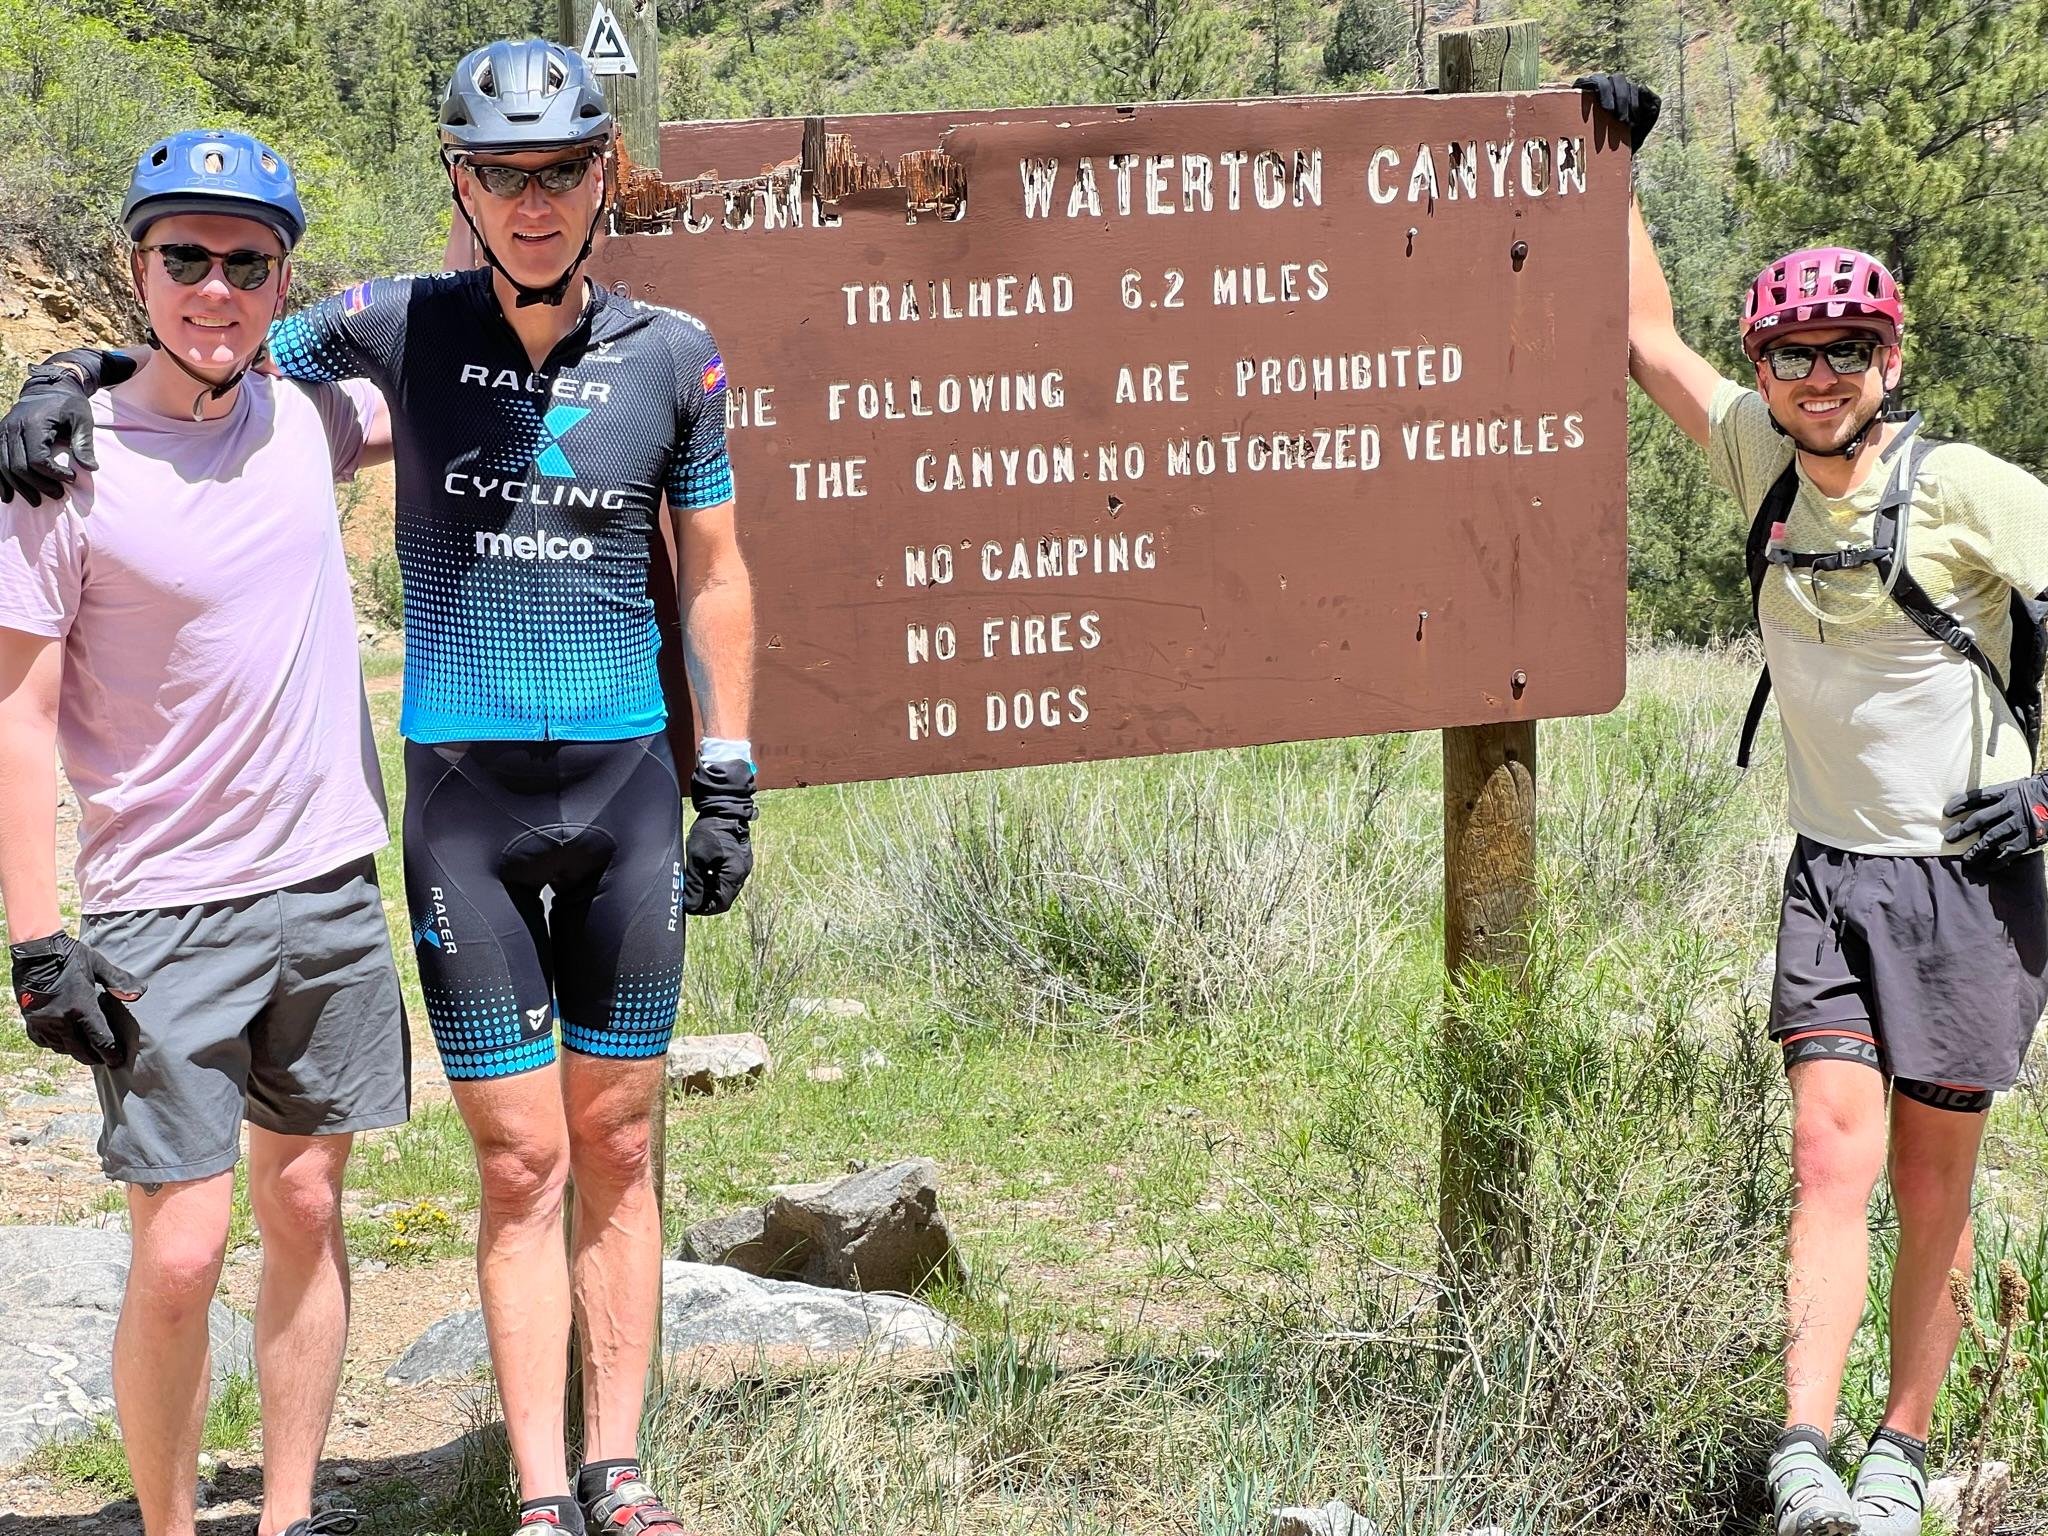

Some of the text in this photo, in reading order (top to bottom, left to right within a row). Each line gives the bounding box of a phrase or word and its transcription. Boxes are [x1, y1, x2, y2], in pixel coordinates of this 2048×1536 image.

[1018, 147, 1323, 218] WATERTON
[1367, 137, 1588, 204] CANYON
[841, 258, 1330, 325] TRAILHEAD 6.2 MILES
[459, 364, 612, 403] RACER
[726, 343, 1464, 429] HE FOLLOWING ARE PROHIBITED
[789, 457, 868, 500] THE
[1167, 423, 1381, 477] MOTORIZED
[1402, 410, 1585, 461] VEHICLES
[444, 473, 627, 510] CYCLING
[475, 530, 594, 561] melco
[905, 531, 1157, 587] NO CAMPING
[906, 610, 1101, 664] NO FIRES
[907, 684, 1089, 741] NO DOGS
[430, 886, 458, 955] RACER
[667, 860, 681, 932] RACER
